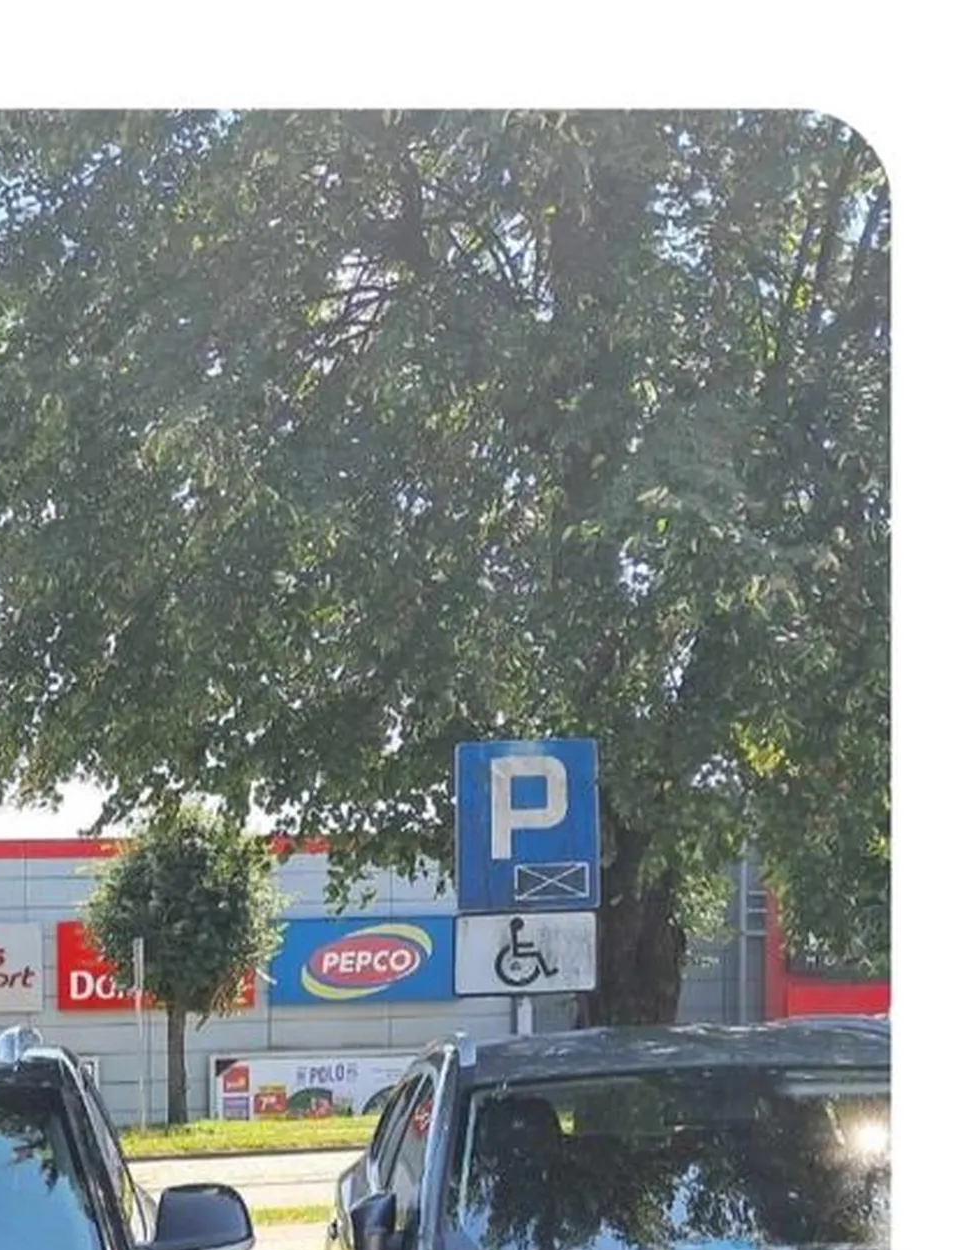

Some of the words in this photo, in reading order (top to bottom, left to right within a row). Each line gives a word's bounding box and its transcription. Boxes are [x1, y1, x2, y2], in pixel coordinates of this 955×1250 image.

[491, 755, 568, 859] P
[322, 950, 412, 974] PEPCO
[310, 1063, 345, 1084] POLO
